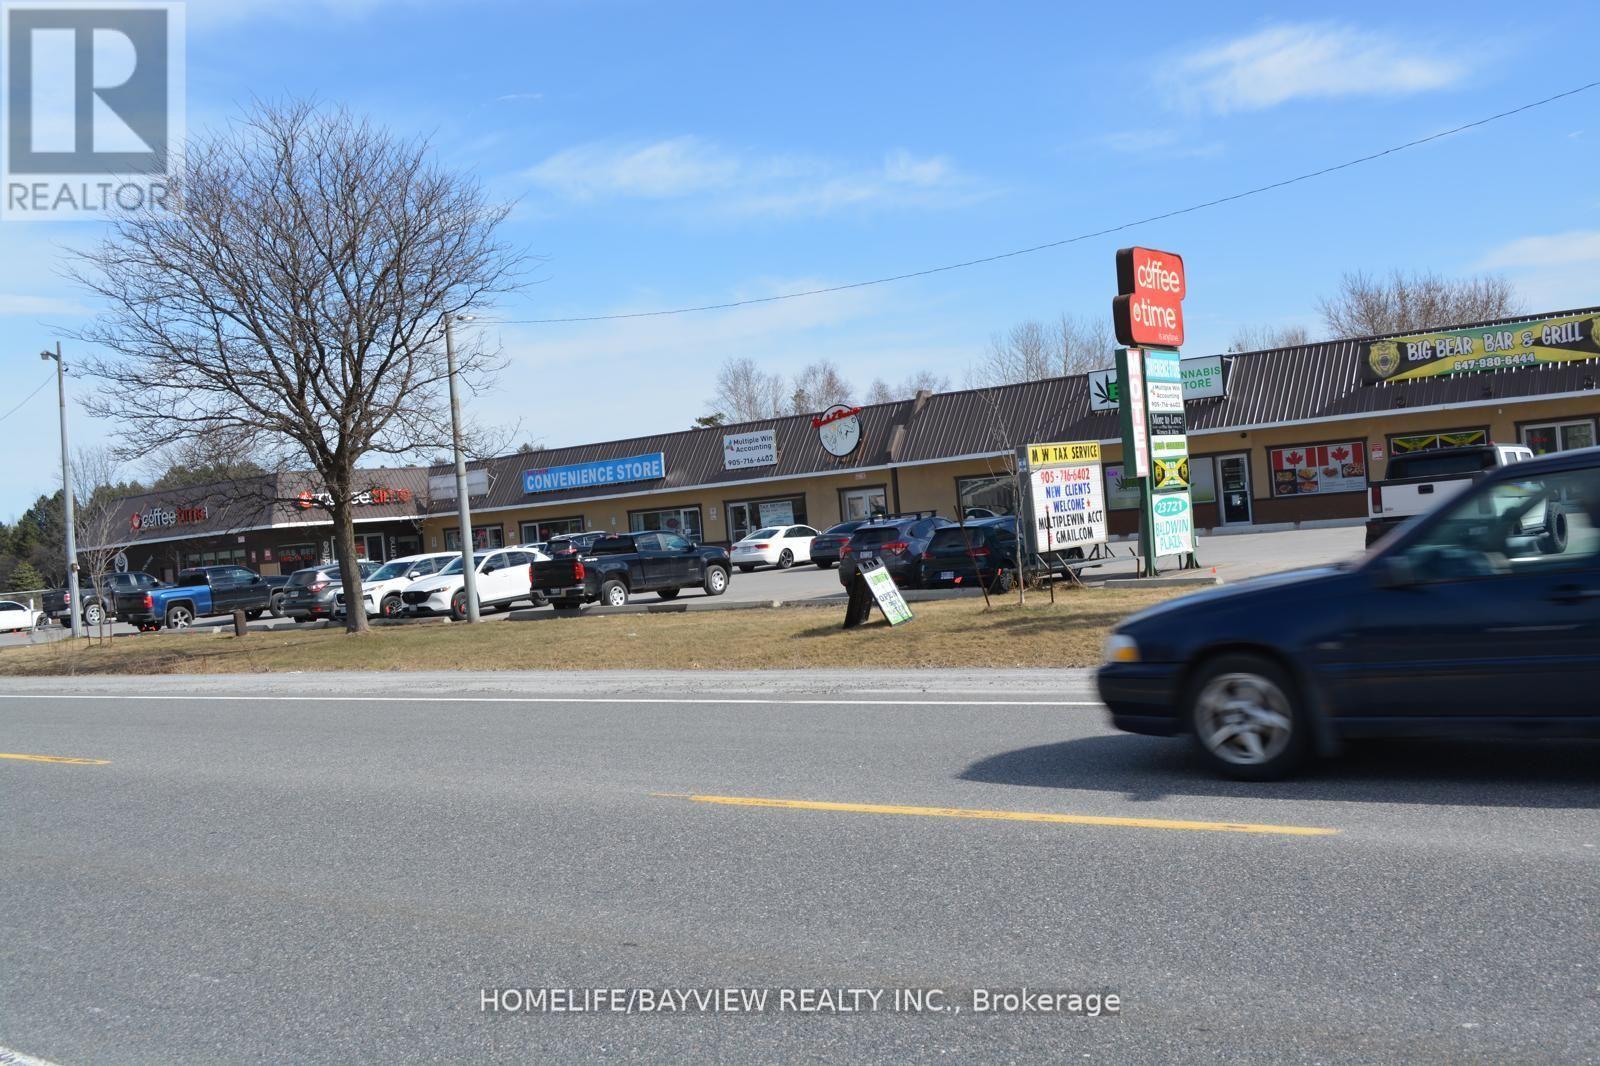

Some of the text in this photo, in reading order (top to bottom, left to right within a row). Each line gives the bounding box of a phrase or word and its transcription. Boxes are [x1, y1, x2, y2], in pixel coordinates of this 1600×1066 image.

[1137, 258, 1180, 292] coffee
[1141, 298, 1176, 329] time
[1406, 322, 1584, 361] BIG BEAR BAR & GRILL
[1180, 366, 1221, 380] NNABIS
[1183, 377, 1212, 391] TORE
[733, 437, 760, 446] Multiple
[736, 443, 772, 453] Accounting
[1053, 446, 1069, 460] TAX
[1072, 444, 1098, 459] SERVICE
[727, 454, 774, 467] 905-716-6402
[526, 460, 660, 490] CONVENIENCE STORE
[1045, 482, 1091, 499] NEW CLIENTS
[1053, 498, 1086, 513] WELCOME
[142, 507, 177, 528] coffee
[1087, 510, 1103, 524] ACCT
[1056, 526, 1094, 544] GMAIL.COM
[1155, 519, 1189, 537] BALDWIN
[1160, 534, 1184, 549] PLAZA
